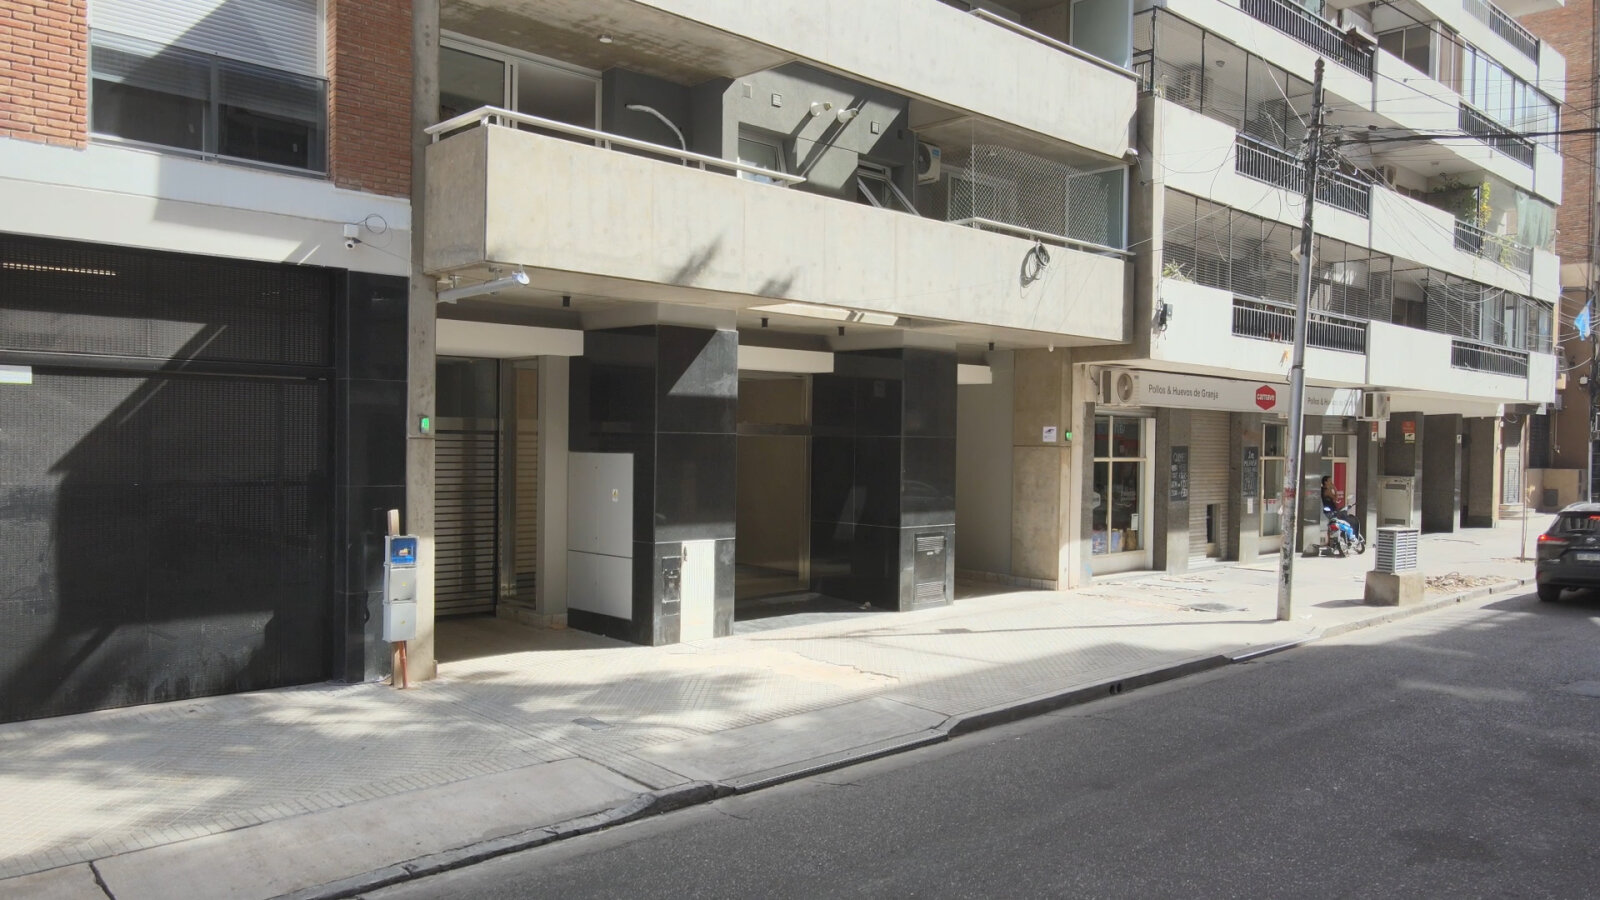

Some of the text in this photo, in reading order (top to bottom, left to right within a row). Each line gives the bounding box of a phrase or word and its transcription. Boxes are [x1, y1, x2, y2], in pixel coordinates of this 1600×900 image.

[1148, 384, 1219, 400] Pollos & Huevos de Granja
